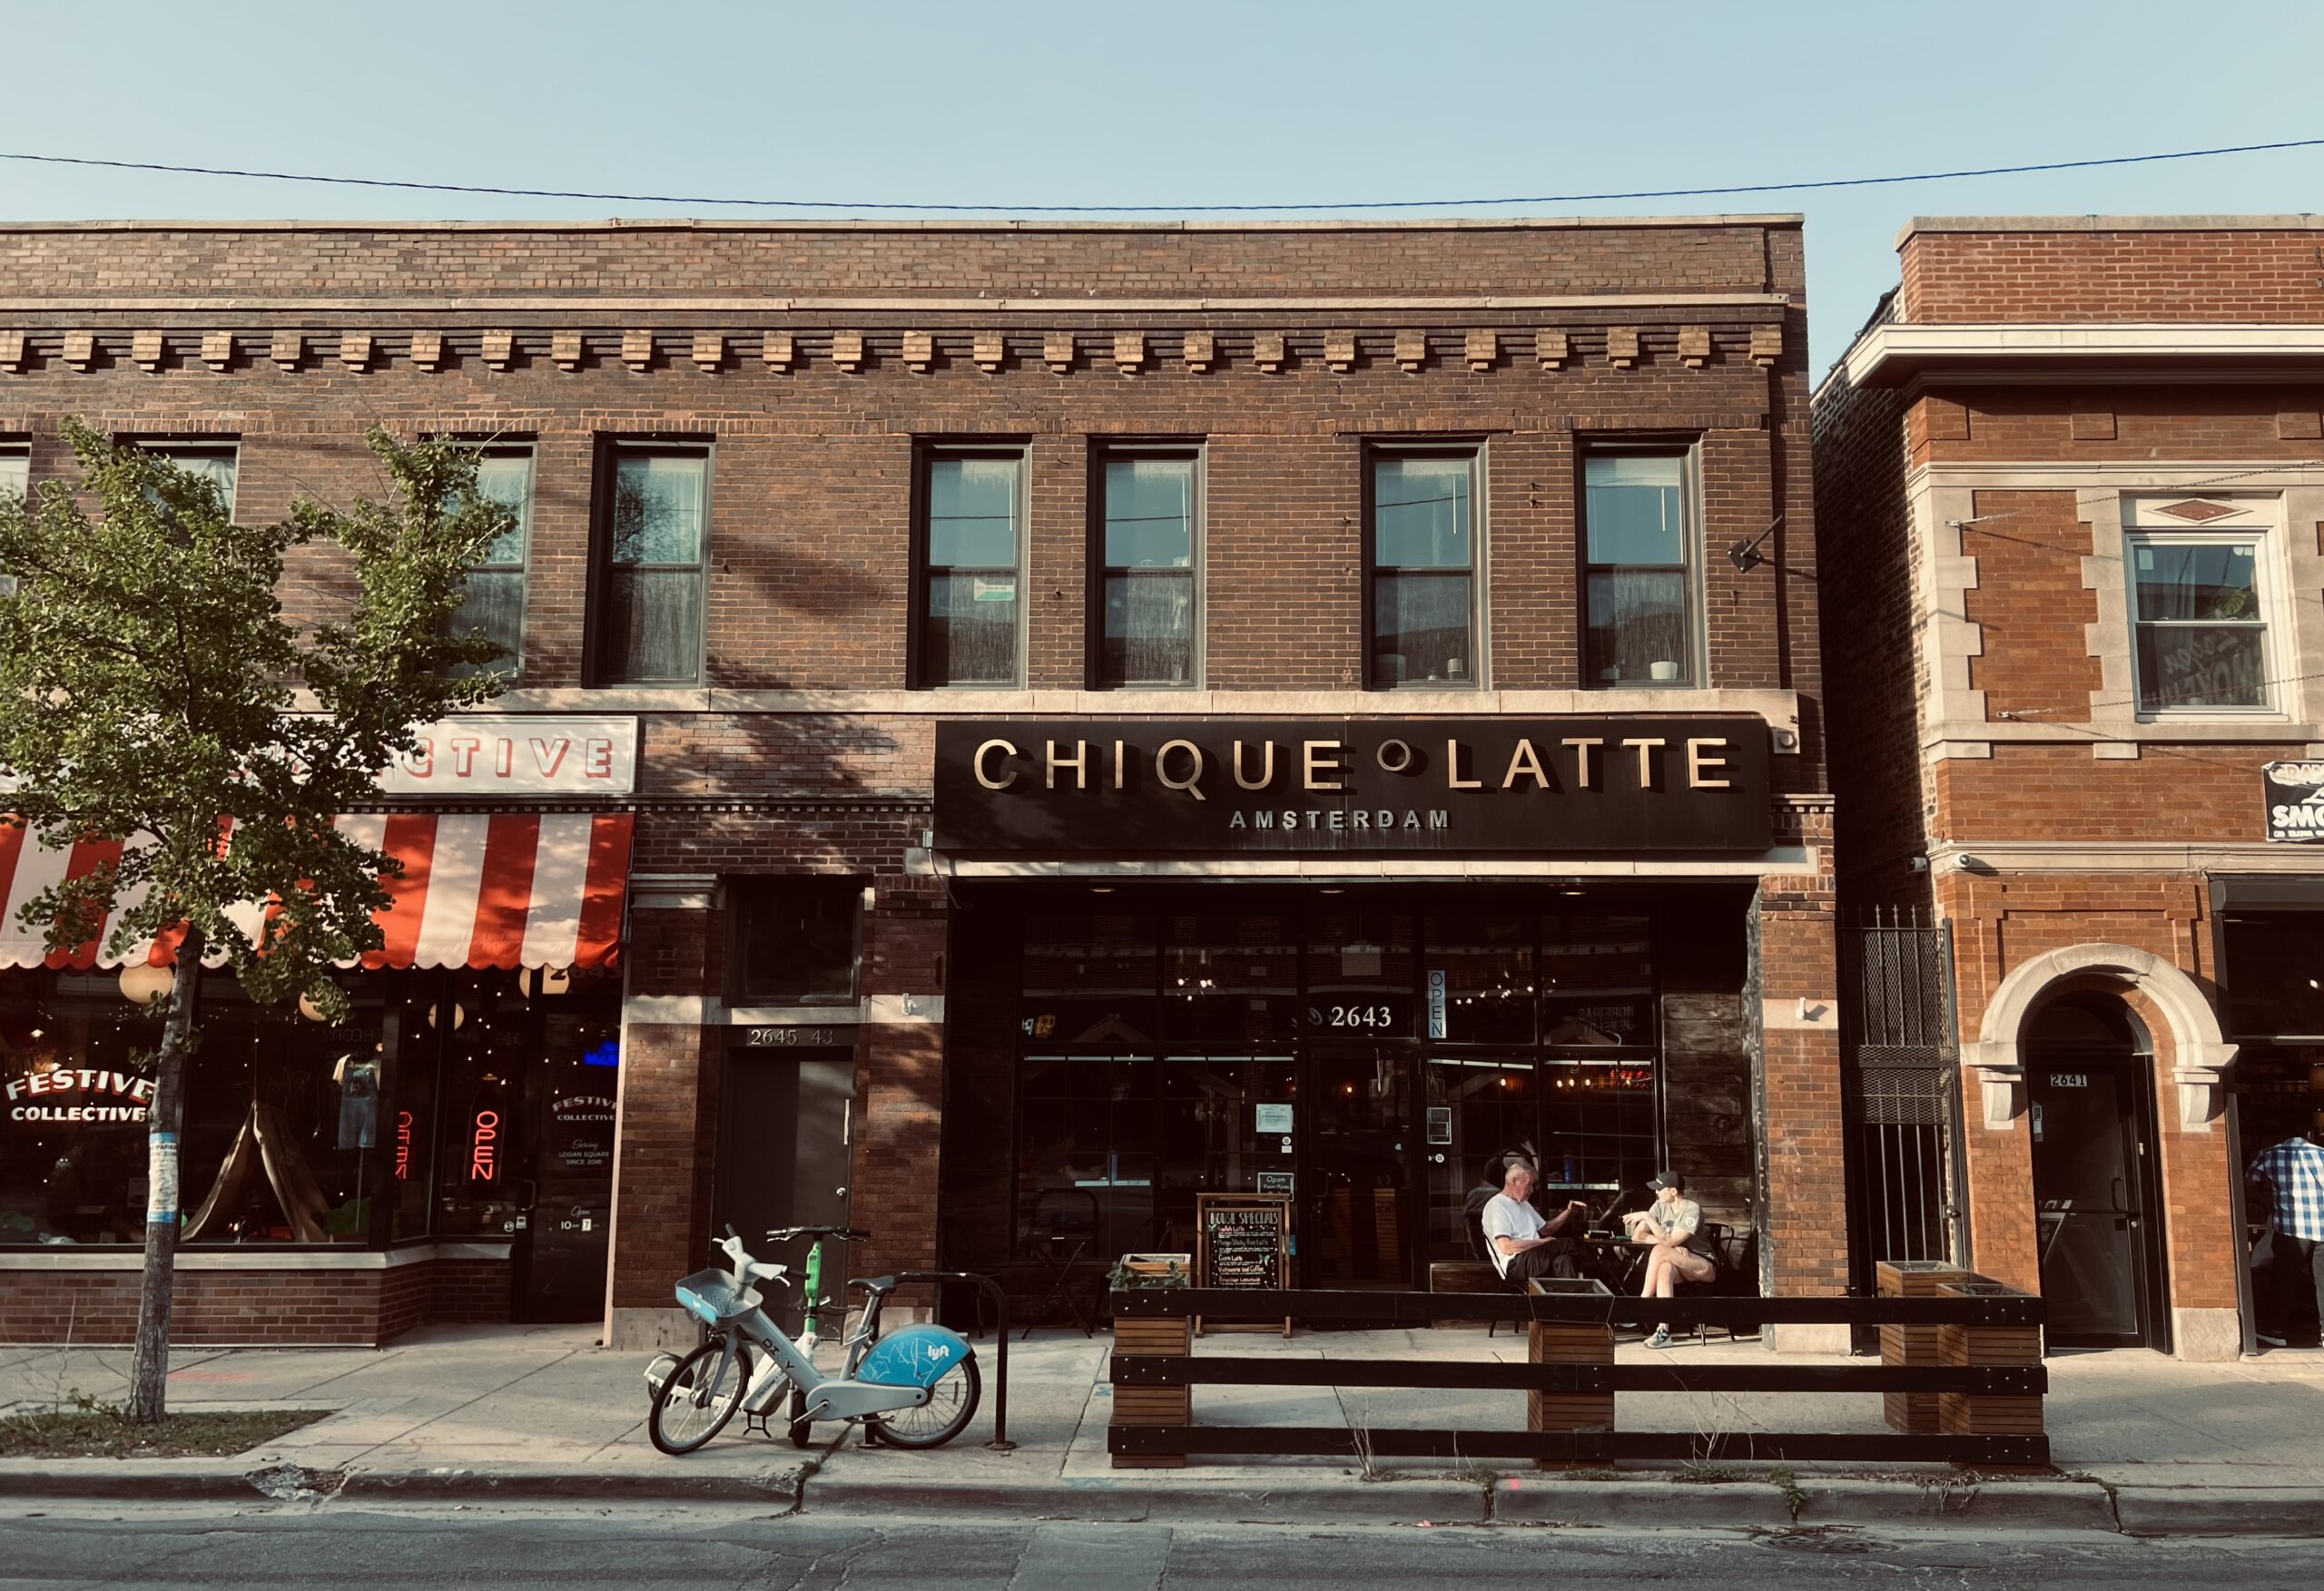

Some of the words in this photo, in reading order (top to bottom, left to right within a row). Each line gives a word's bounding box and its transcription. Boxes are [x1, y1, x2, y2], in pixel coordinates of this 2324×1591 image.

[401, 737, 614, 779] CTIVE
[973, 738, 1344, 800] CHIQUE
[1449, 737, 1732, 791] LATTE
[1229, 809, 1452, 830] AMSTERDAM
[1430, 972, 1443, 1036] OPEN
[1331, 1006, 1392, 1027] 2643
[750, 1029, 797, 1046] 2645
[811, 1029, 833, 1045] 43
[5, 1069, 158, 1105] FESTIVE
[2052, 1075, 2086, 1085] 2641
[11, 1106, 147, 1122] COLLECTIVE
[1753, 1016, 1766, 1203] COFFEE
[471, 1110, 498, 1180] OPEN
[584, 1151, 610, 1159] SQUARE
[1266, 1175, 1285, 1184] Open
[1210, 1212, 1236, 1224] HOUSE
[1238, 1212, 1278, 1224] SPECIALS
[928, 1345, 950, 1360] lyft
